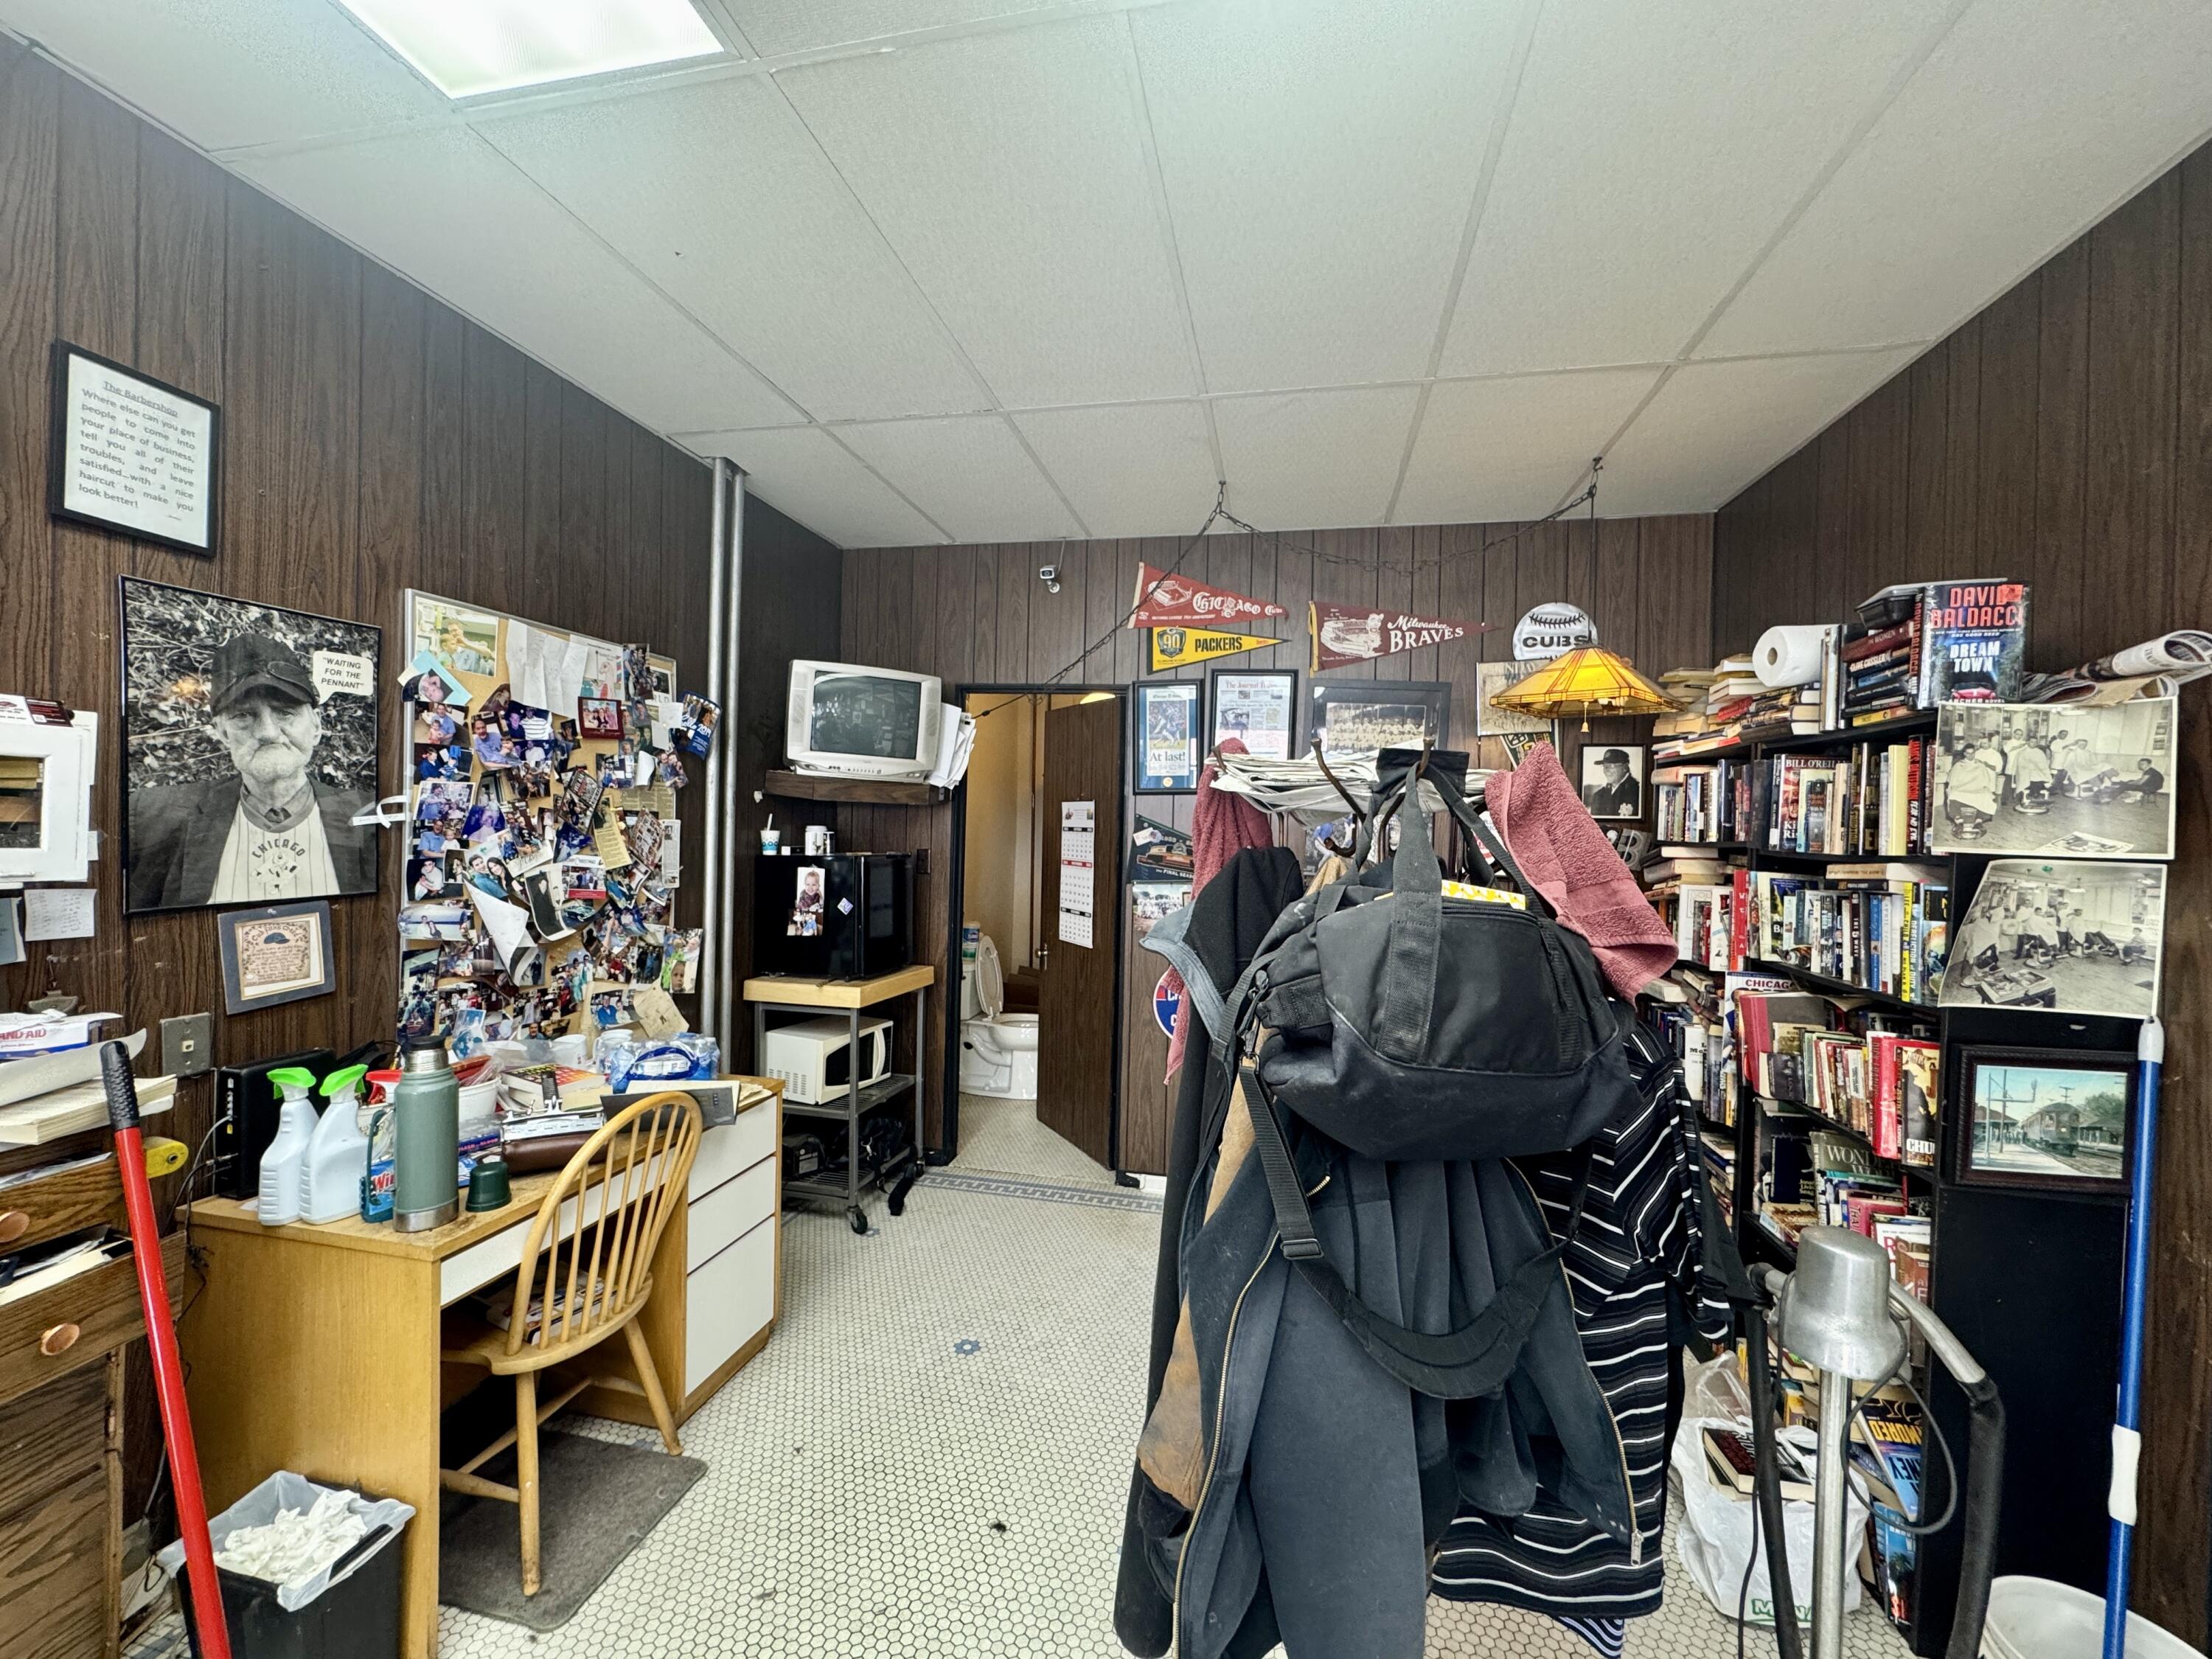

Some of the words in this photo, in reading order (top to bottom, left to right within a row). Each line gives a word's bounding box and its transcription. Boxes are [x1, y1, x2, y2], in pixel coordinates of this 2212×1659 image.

[102, 381, 122, 394] The
[125, 389, 178, 417] Barbershop
[82, 389, 116, 408] Where
[120, 405, 139, 417] else
[142, 414, 159, 424] can
[161, 419, 178, 432] you
[181, 428, 195, 437] get
[82, 403, 116, 421] people
[125, 418, 136, 428] to
[144, 427, 170, 441] come
[177, 438, 195, 450] into
[80, 417, 105, 431] your
[109, 427, 136, 442] place
[139, 437, 149, 446] of
[153, 441, 195, 463] business,
[80, 430, 97, 441] tell
[106, 439, 125, 451] you
[136, 448, 146, 458] all
[173, 462, 194, 474] their
[80, 443, 125, 465] troubles,
[139, 464, 157, 475] and
[170, 473, 194, 487] leave
[79, 470, 116, 488] haircut
[124, 484, 135, 494] to
[143, 491, 169, 504] make
[176, 501, 193, 512] you
[79, 483, 102, 497] look
[104, 490, 138, 508] better!
[175, 488, 194, 499] nice
[1193, 591, 1261, 615] CHICAGO
[1388, 615, 1449, 630] Milwaukee
[1930, 606, 2024, 629] BALDACCI
[1164, 635, 1179, 648] 90
[1194, 637, 1242, 653] PACKERS
[1389, 627, 1464, 653] BRAVES
[1522, 634, 1588, 648] CUBS
[1950, 641, 2000, 658] DREAM
[1864, 653, 1885, 667] CUSSLER
[1954, 656, 1993, 672] TOWN
[325, 668, 342, 676] FOR
[1150, 751, 1162, 762] At
[1165, 751, 1186, 762] last!
[1908, 740, 1920, 761] JAMES
[1786, 759, 1806, 768] BILL
[1808, 759, 1840, 768] O'REIL
[1907, 764, 1920, 799] PATTERSON
[251, 838, 306, 859] CHICAGO
[1910, 920, 1918, 963] DERELICTION
[0, 1028, 47, 1040] AND-AID
[1907, 1138, 1935, 1154] CHU
[1868, 1420, 1922, 1444] MORED
